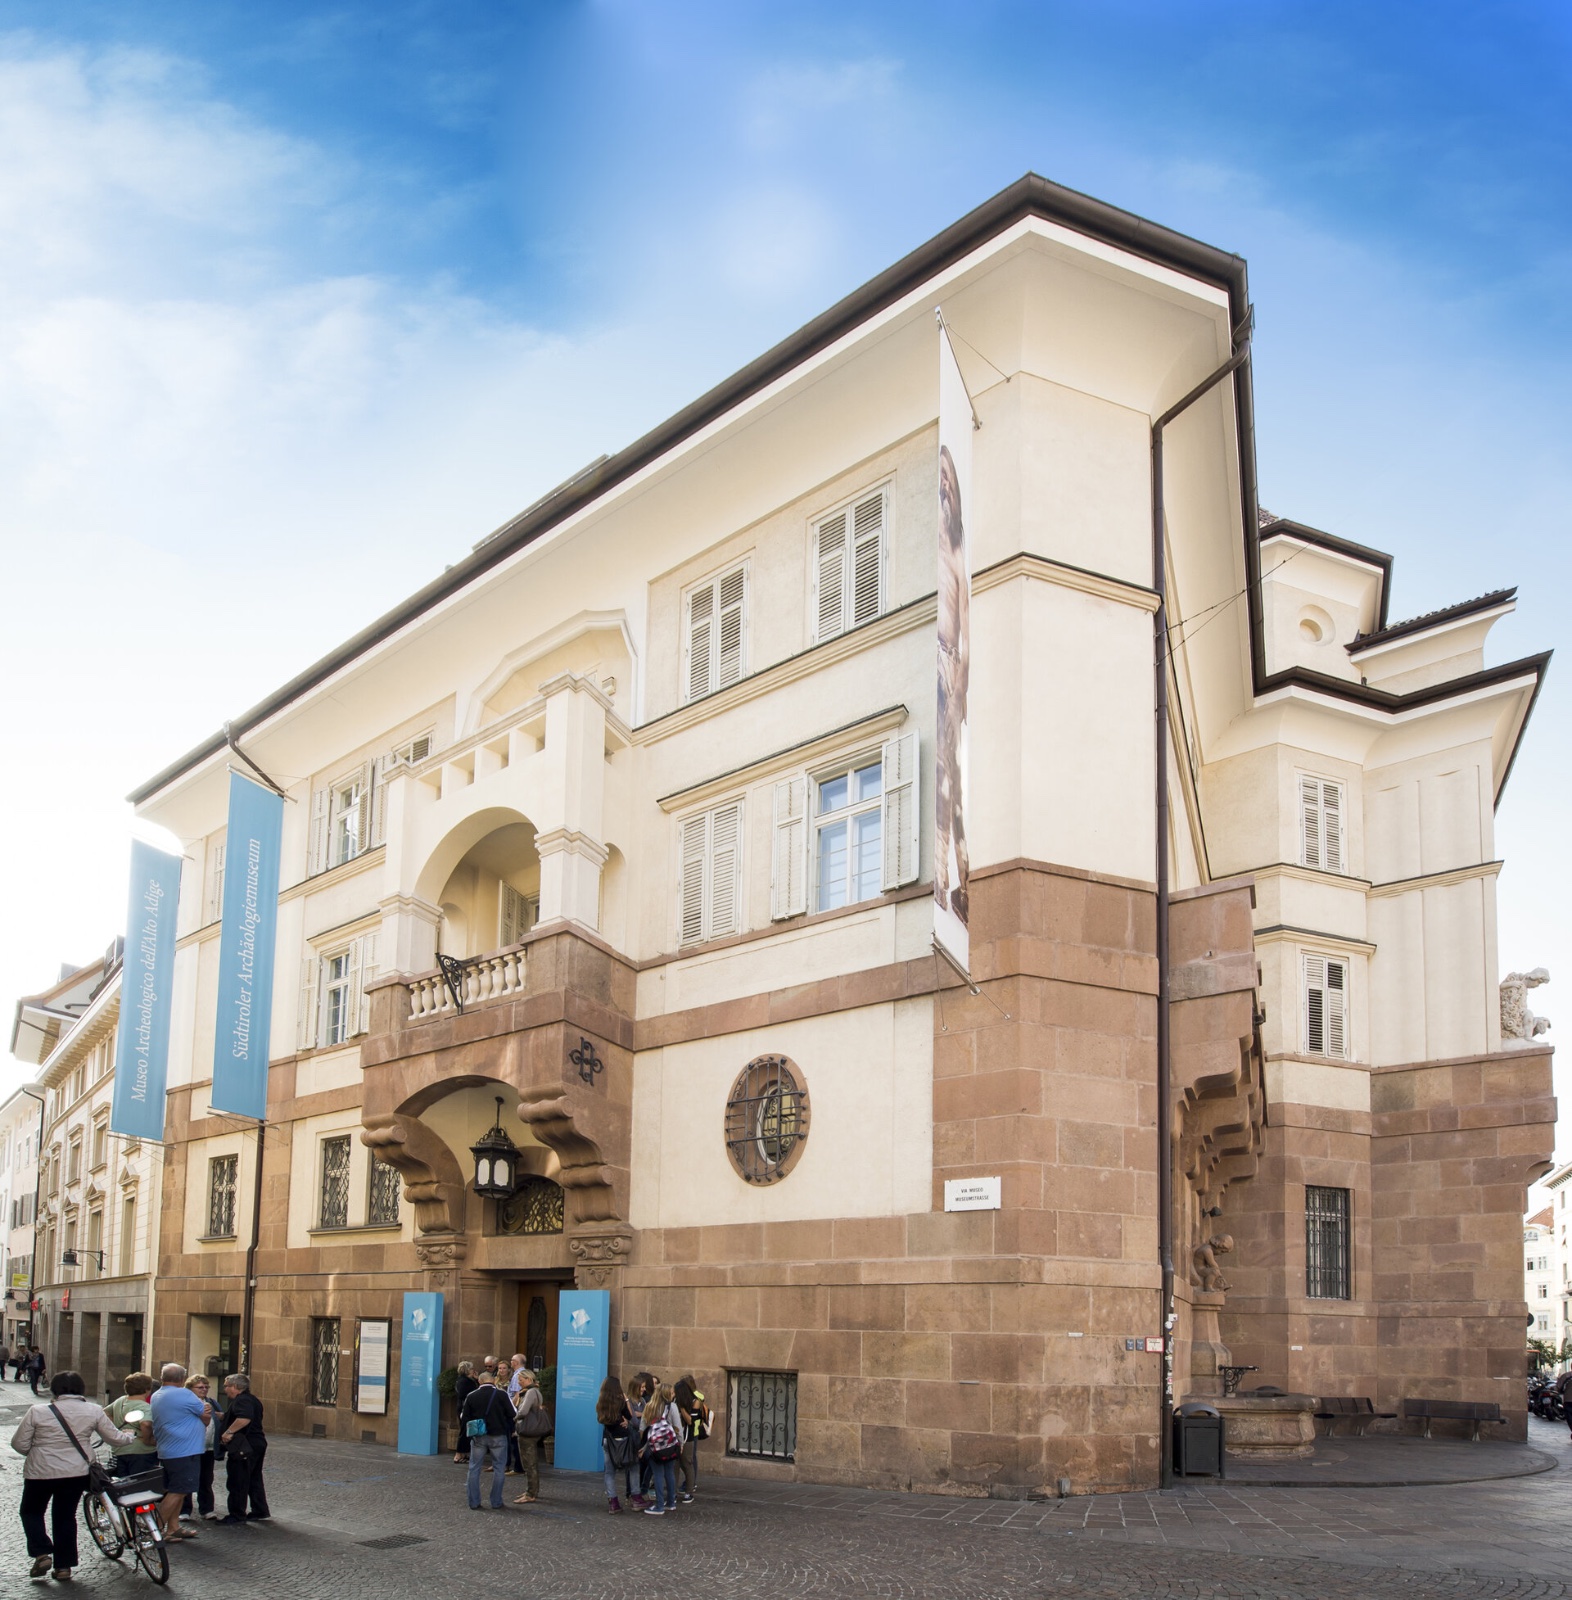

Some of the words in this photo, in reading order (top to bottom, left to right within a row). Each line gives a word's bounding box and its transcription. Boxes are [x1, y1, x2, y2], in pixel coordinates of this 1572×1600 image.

[144, 880, 164, 917] Adige
[238, 839, 260, 986] Archäologiemuseum
[140, 919, 158, 970] dell'Alto
[135, 972, 157, 1057] Archeologico
[233, 987, 252, 1059] Südtiroler
[131, 1060, 148, 1102] Museo
